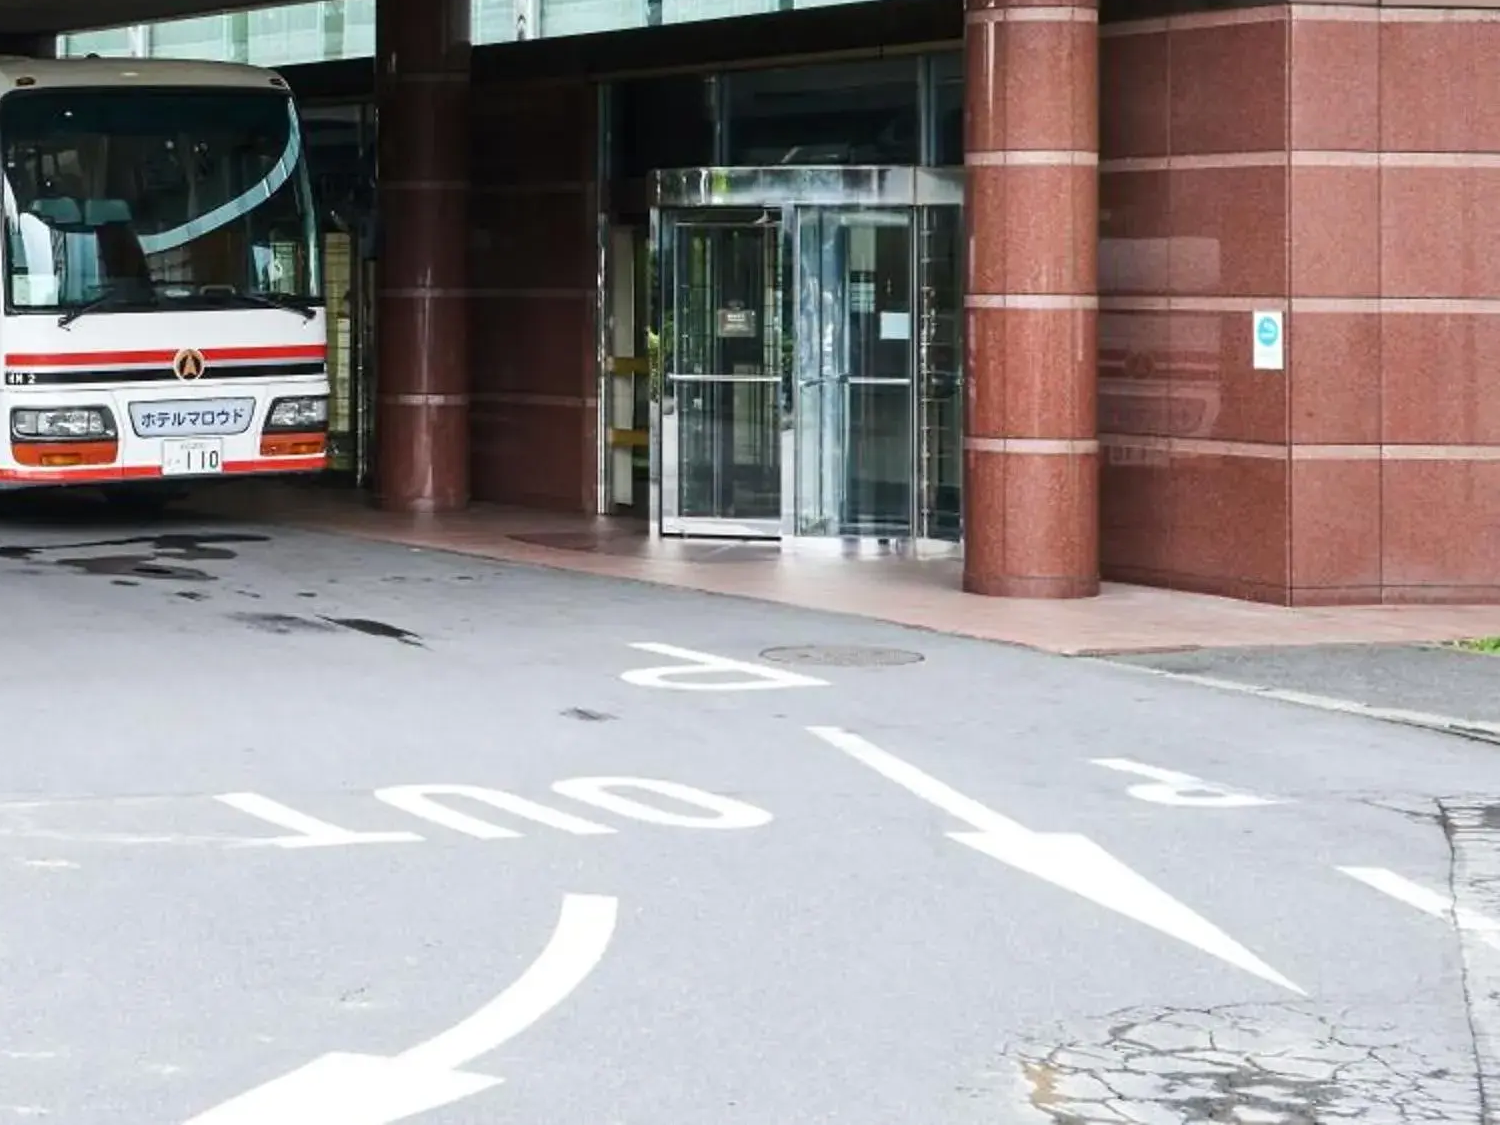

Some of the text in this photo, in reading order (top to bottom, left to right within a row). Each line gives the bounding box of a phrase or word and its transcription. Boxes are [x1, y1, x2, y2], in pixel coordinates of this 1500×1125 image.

[141, 407, 245, 429] ホテルマロウド
[213, 777, 775, 848] OUT
